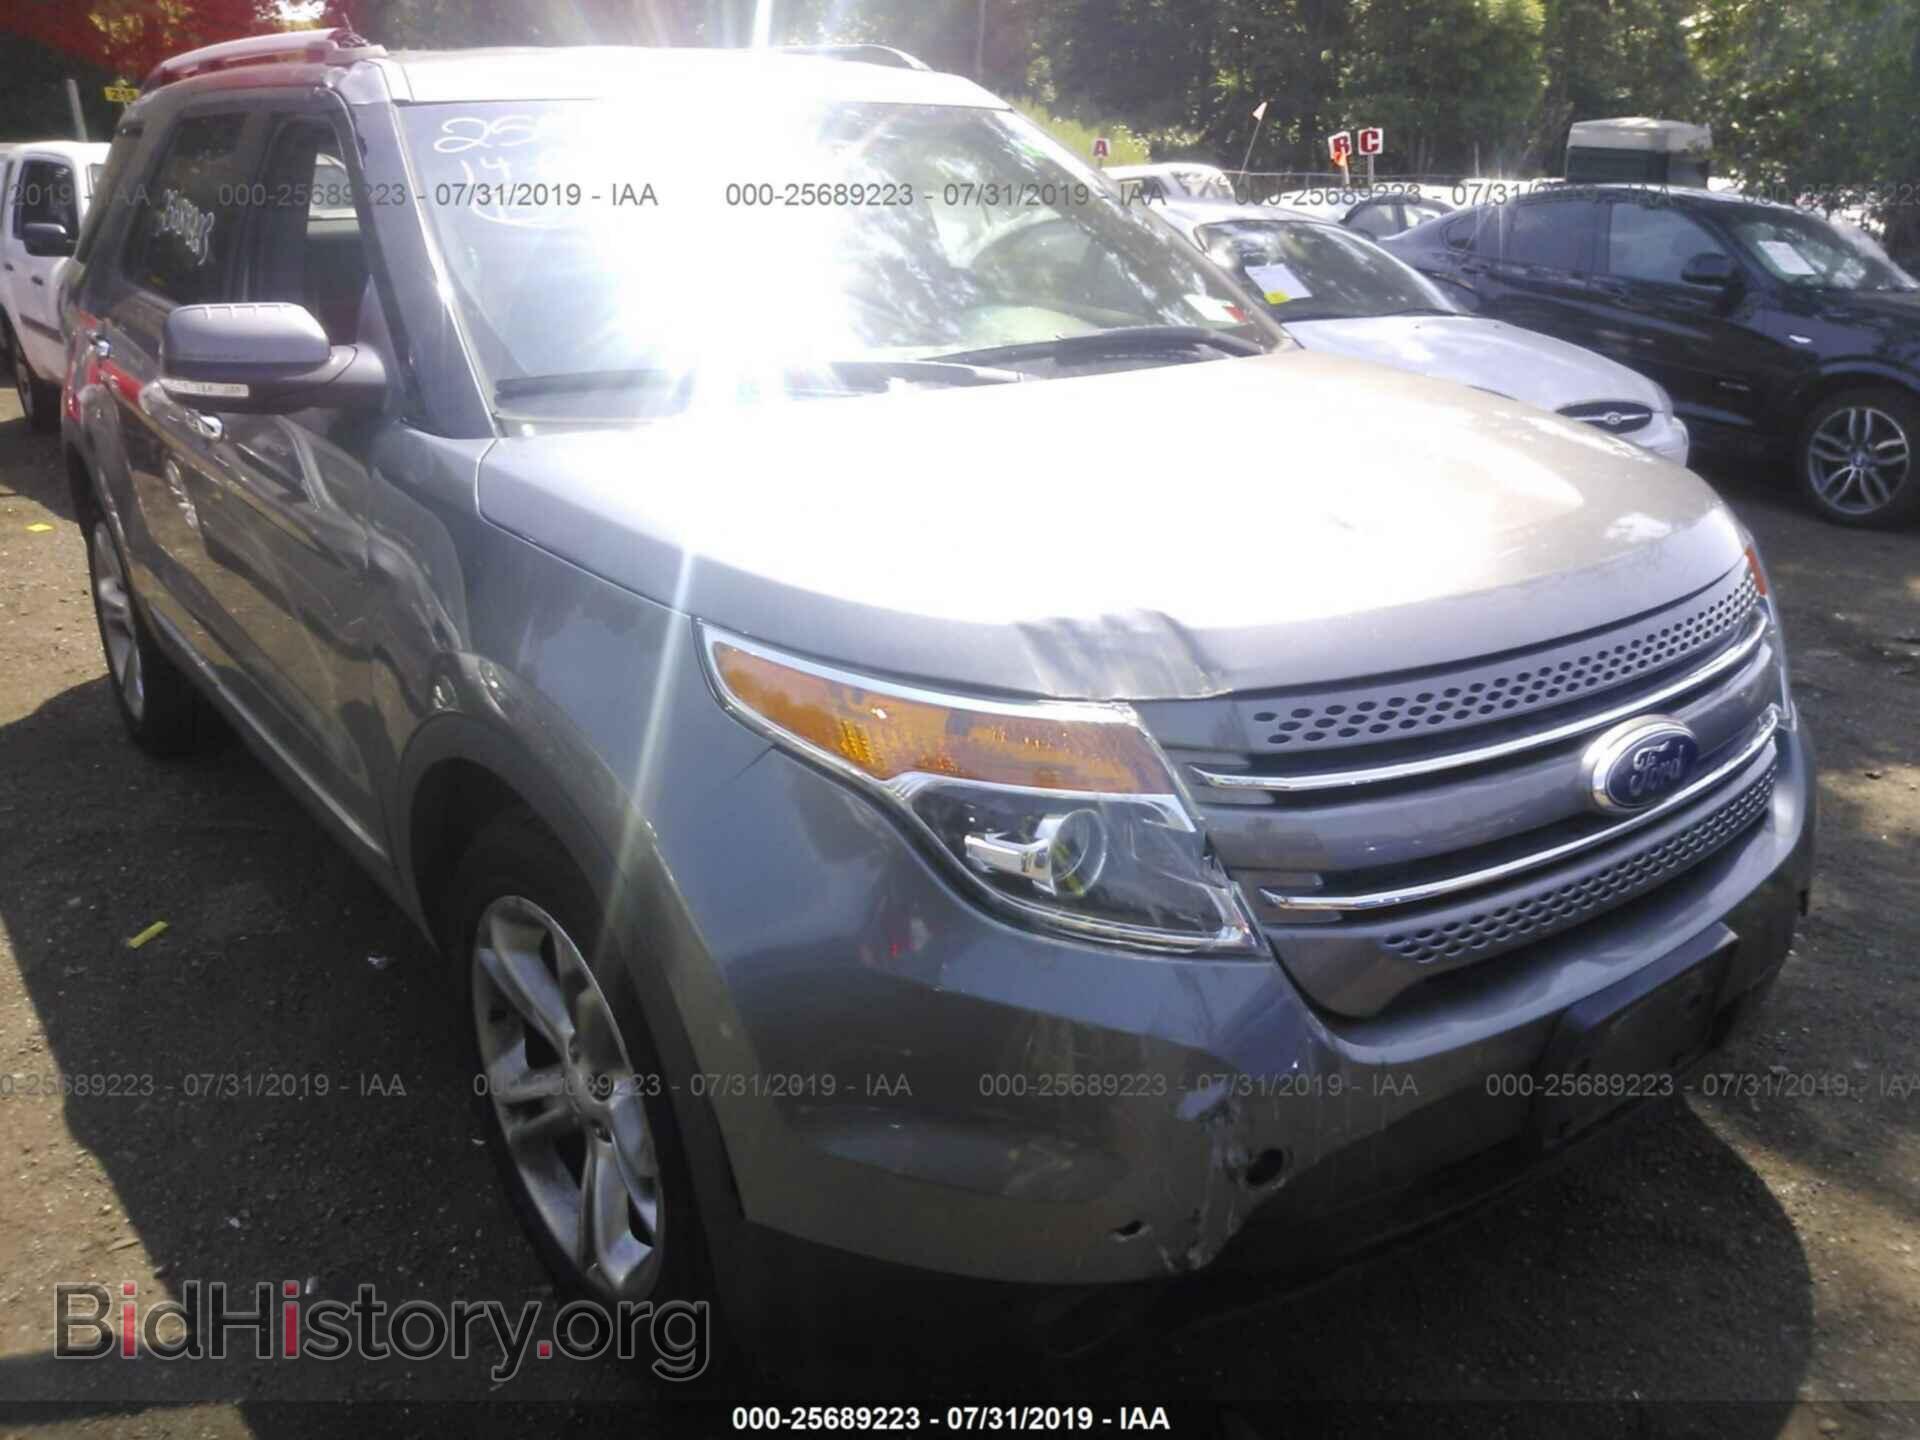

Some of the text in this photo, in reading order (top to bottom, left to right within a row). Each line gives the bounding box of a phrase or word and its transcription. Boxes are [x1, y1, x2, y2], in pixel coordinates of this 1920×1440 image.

[1093, 140, 1108, 156] A
[1360, 130, 1380, 153] C
[1630, 741, 1685, 796] Ford
